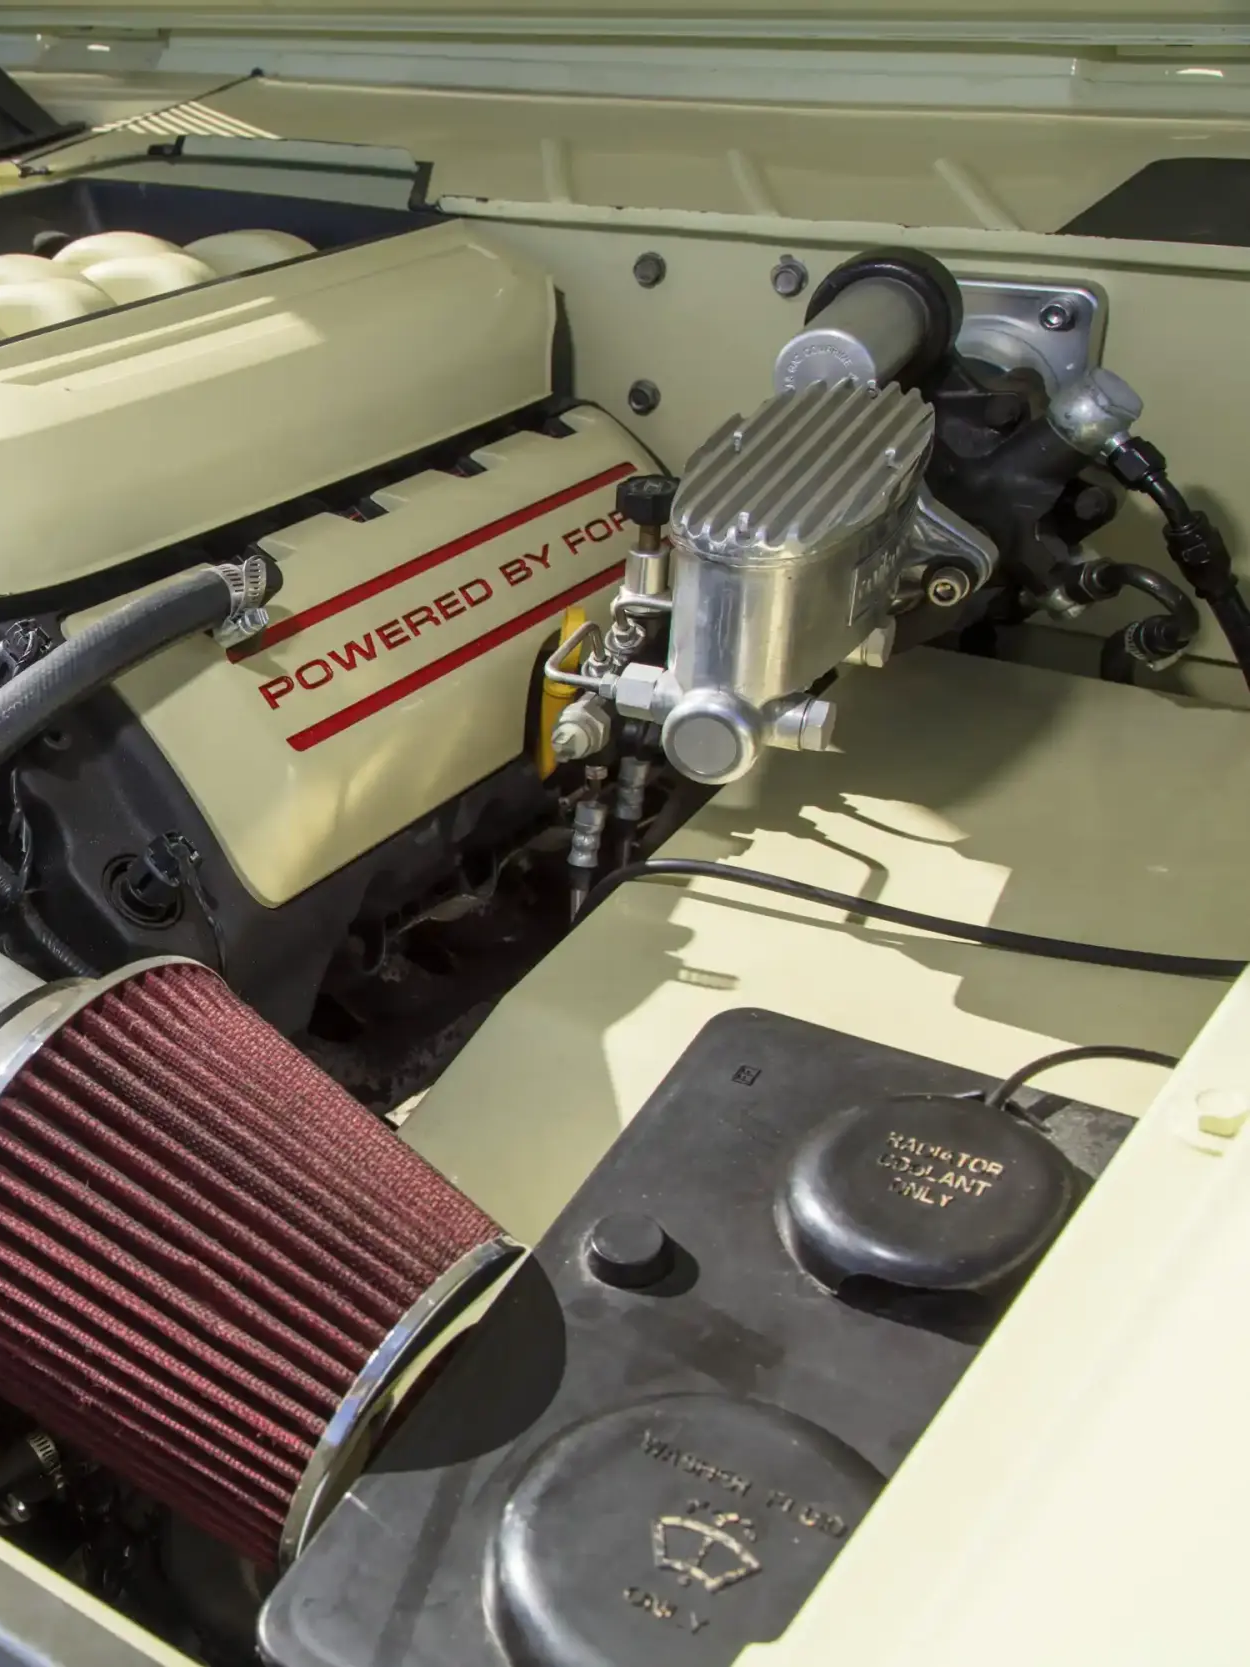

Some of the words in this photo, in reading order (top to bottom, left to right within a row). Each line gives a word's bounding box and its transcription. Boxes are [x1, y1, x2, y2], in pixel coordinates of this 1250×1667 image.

[258, 578, 494, 710] POWERED
[499, 543, 552, 587] BY
[877, 1153, 993, 1197] COOLANT
[888, 1176, 954, 1208] ONLY
